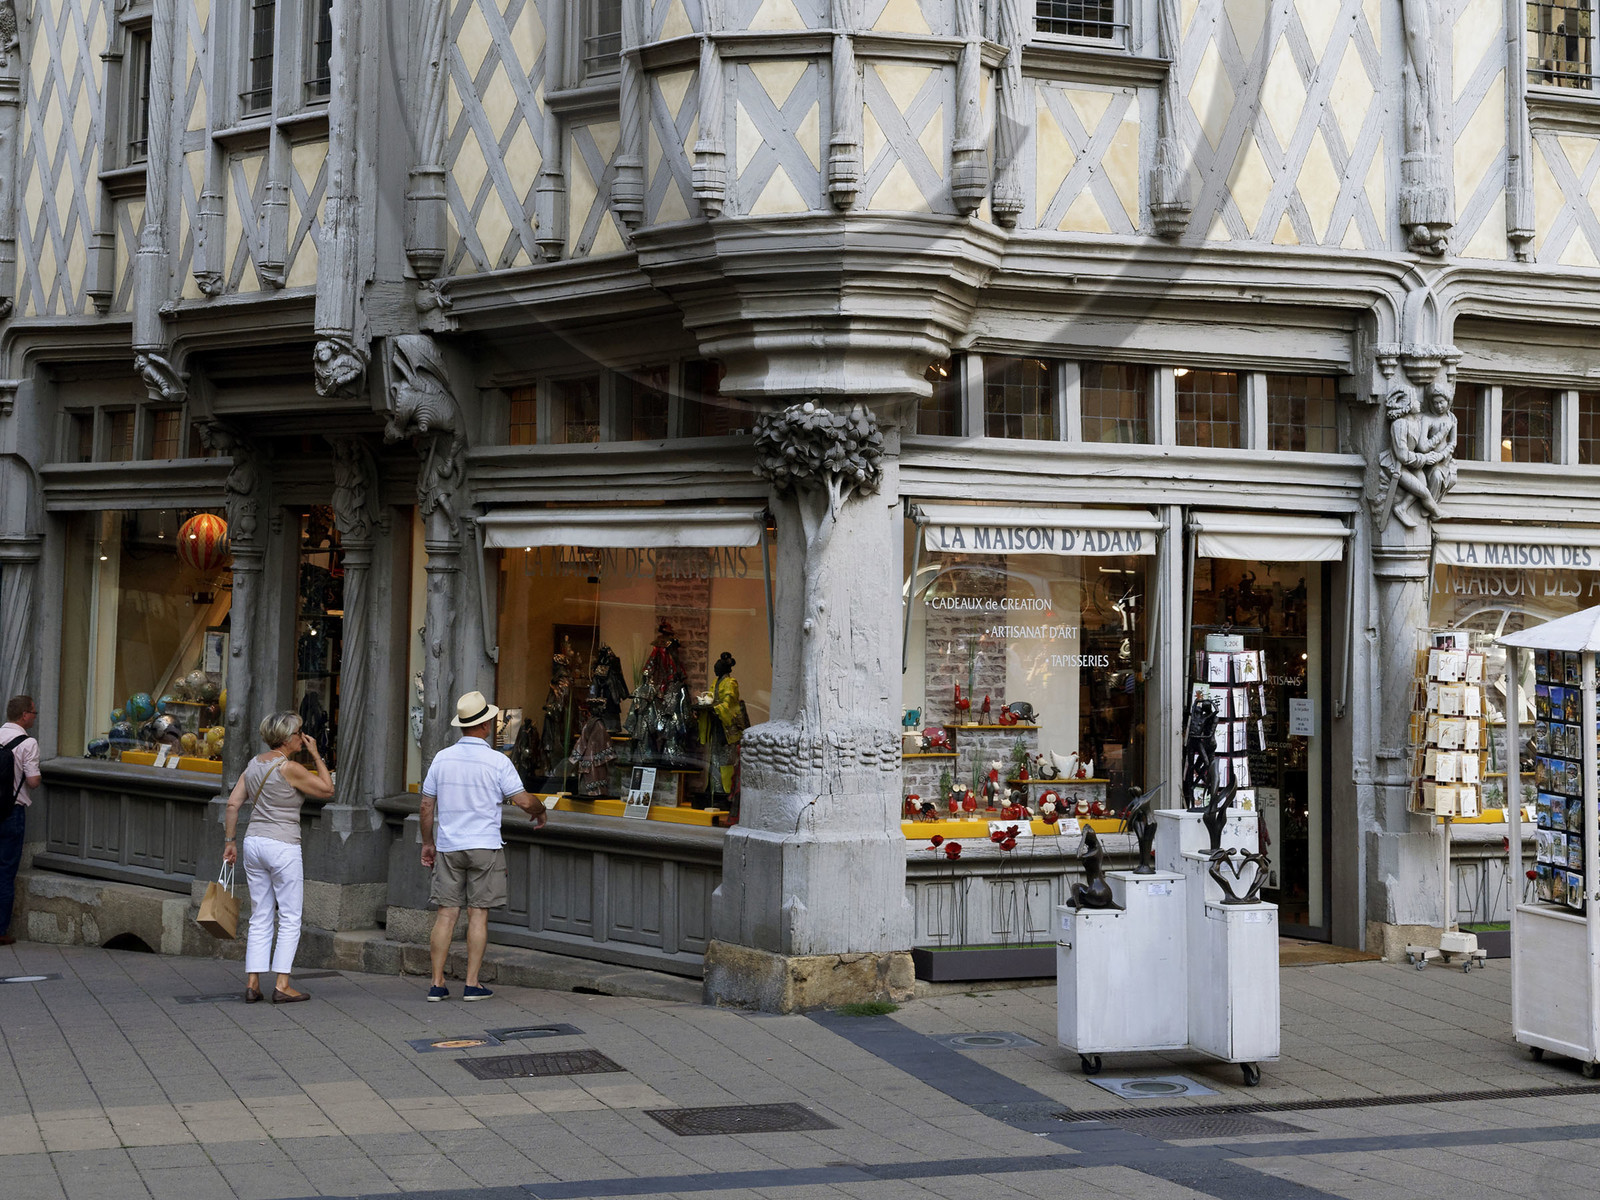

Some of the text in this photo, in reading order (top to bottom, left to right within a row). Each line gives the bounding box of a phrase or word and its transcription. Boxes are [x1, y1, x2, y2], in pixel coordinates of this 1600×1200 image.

[941, 526, 1142, 552] LA MAISON D'ADAM
[626, 548, 656, 578] DES
[1456, 543, 1592, 567] LA MAISON DES
[932, 598, 983, 611] CADEAUX
[985, 599, 997, 610] de
[991, 626, 1045, 639] ARTISANAT
[1051, 655, 1109, 667] TAPISSERIES
